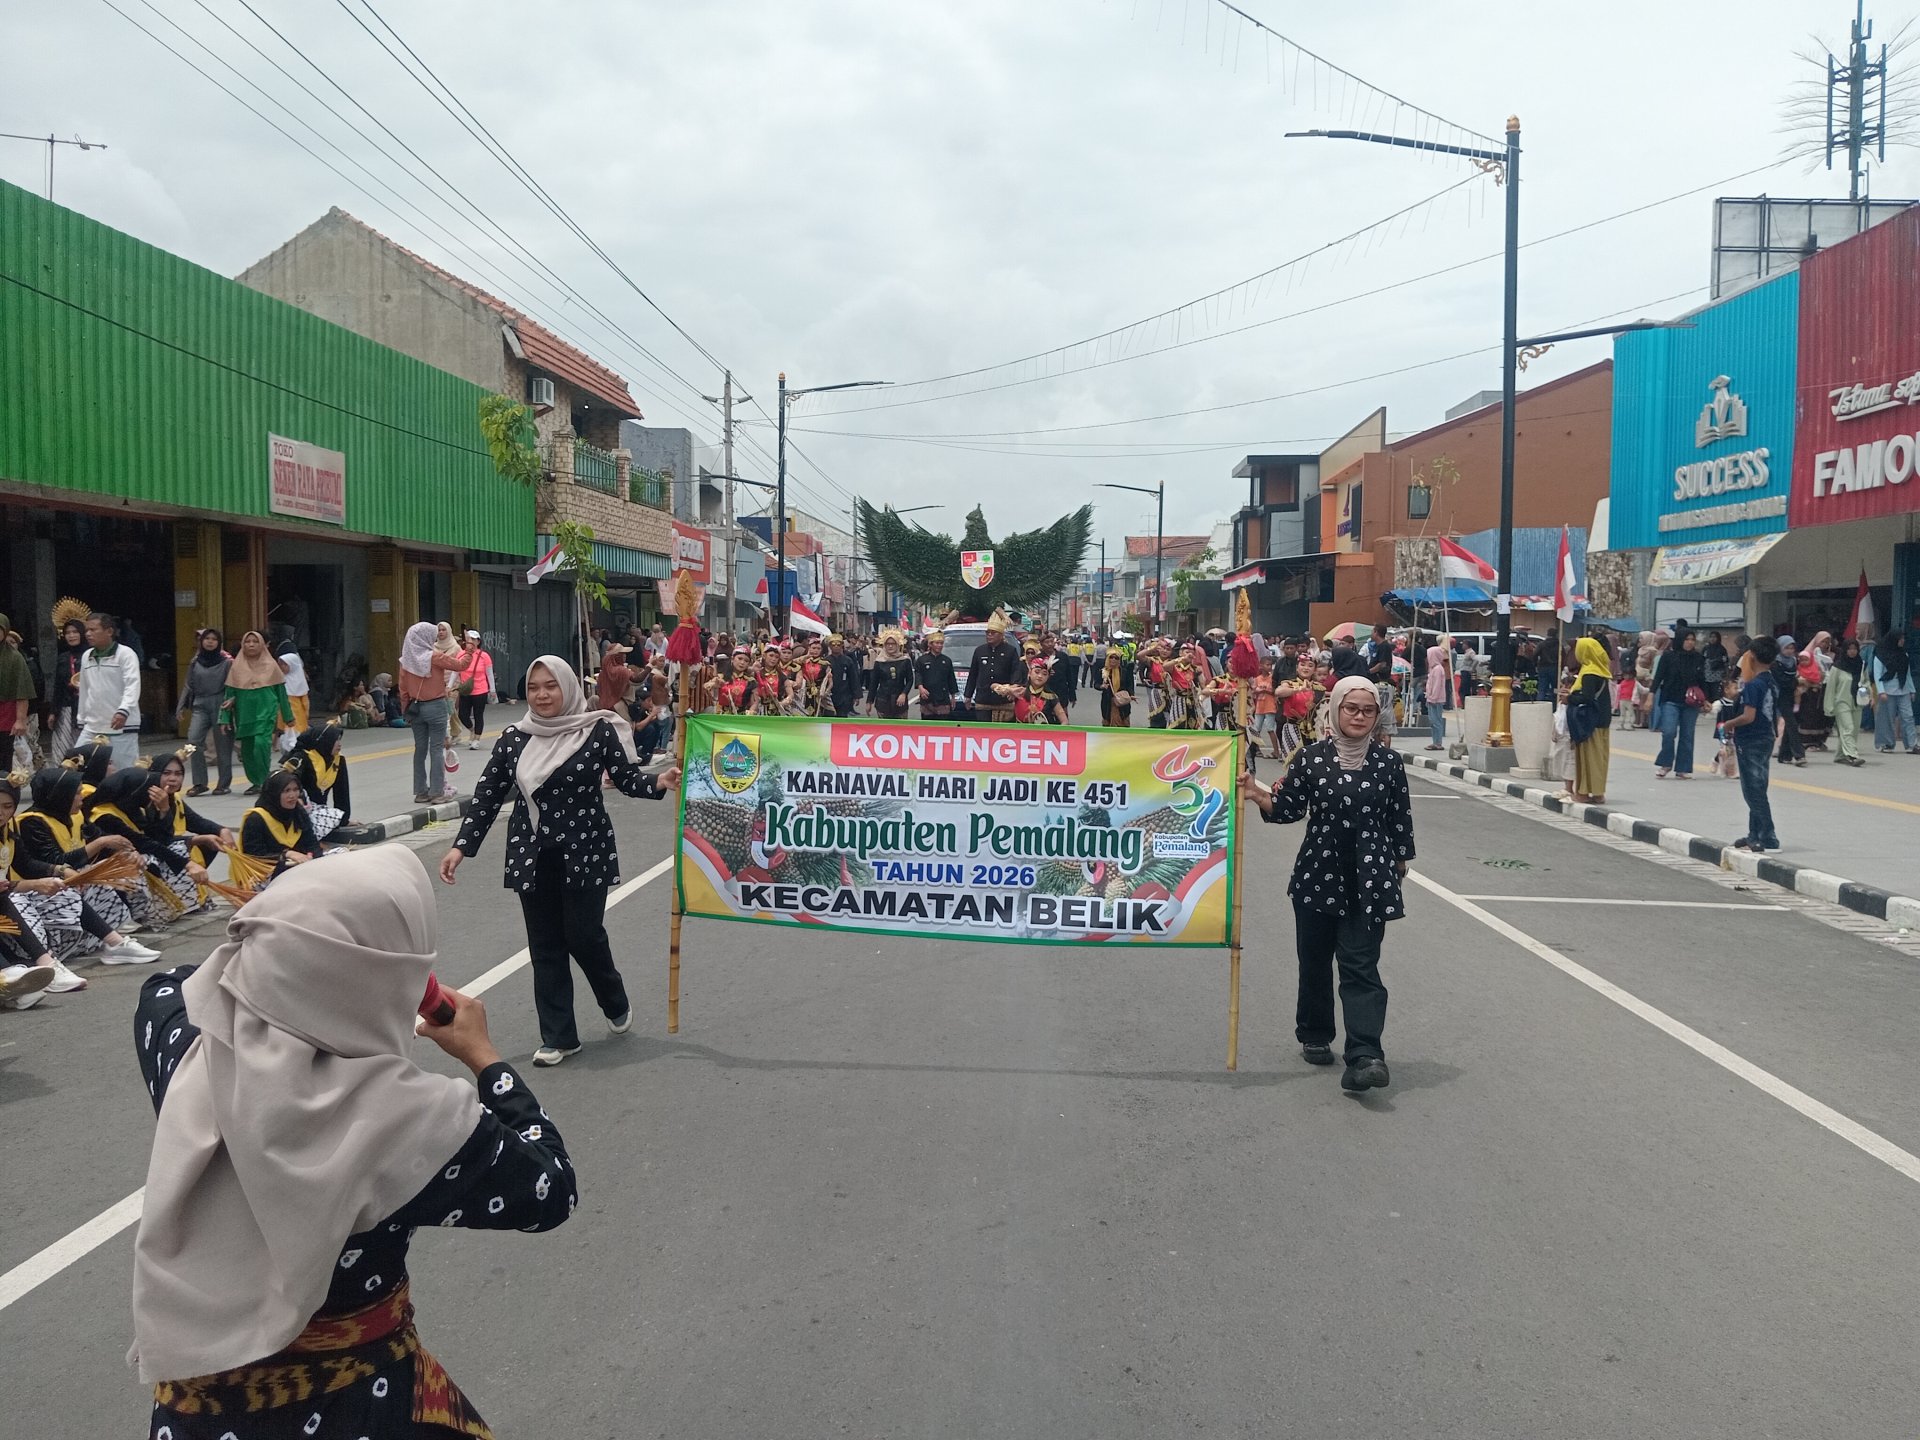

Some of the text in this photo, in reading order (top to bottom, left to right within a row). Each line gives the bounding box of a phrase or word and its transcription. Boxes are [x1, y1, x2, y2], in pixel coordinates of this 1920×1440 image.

[1828, 383, 1892, 416] Istana
[274, 442, 294, 458] TOKO
[1813, 431, 1920, 497] FAMO
[1674, 447, 1770, 500] SUCCESS
[848, 733, 1068, 766] KONTINGEN
[787, 770, 1128, 806] KARNAVAL HARI JADI KE 451
[767, 805, 1142, 871] Kabupaten Pemalang
[1154, 841, 1209, 853] Pemalang
[872, 861, 1035, 886] TAHUN 2026
[741, 884, 1163, 932] KECAMATAN BELIK
